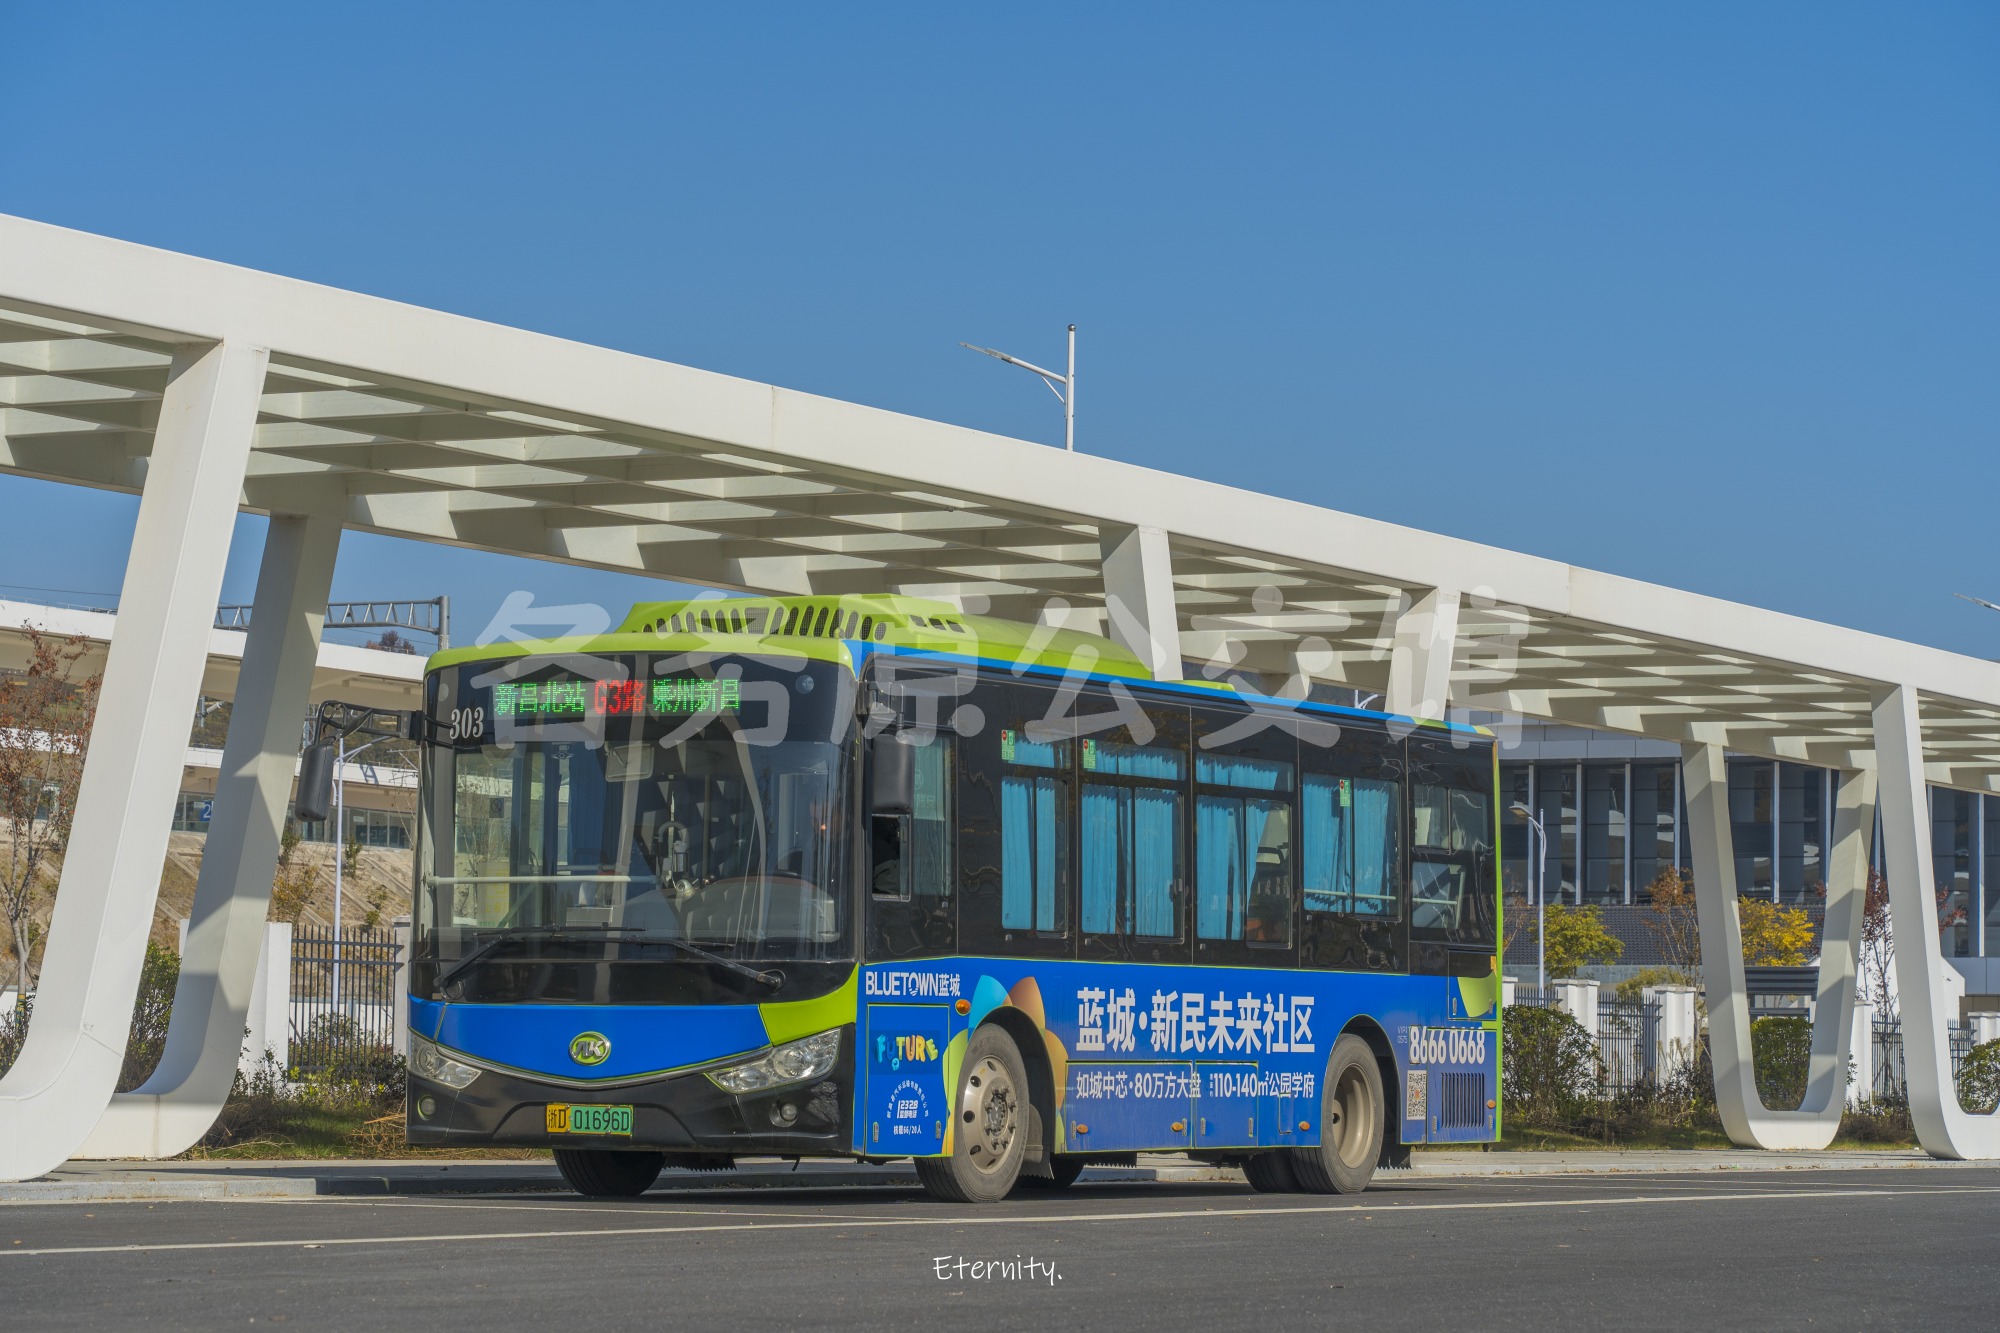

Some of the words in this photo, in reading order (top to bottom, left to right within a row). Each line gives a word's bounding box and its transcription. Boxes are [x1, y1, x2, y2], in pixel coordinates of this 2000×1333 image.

[495, 681, 586, 715] 新昌北站
[594, 679, 646, 714] G3路
[450, 707, 484, 739] 303
[1076, 986, 1315, 1054] 蓝城·新民未来社区
